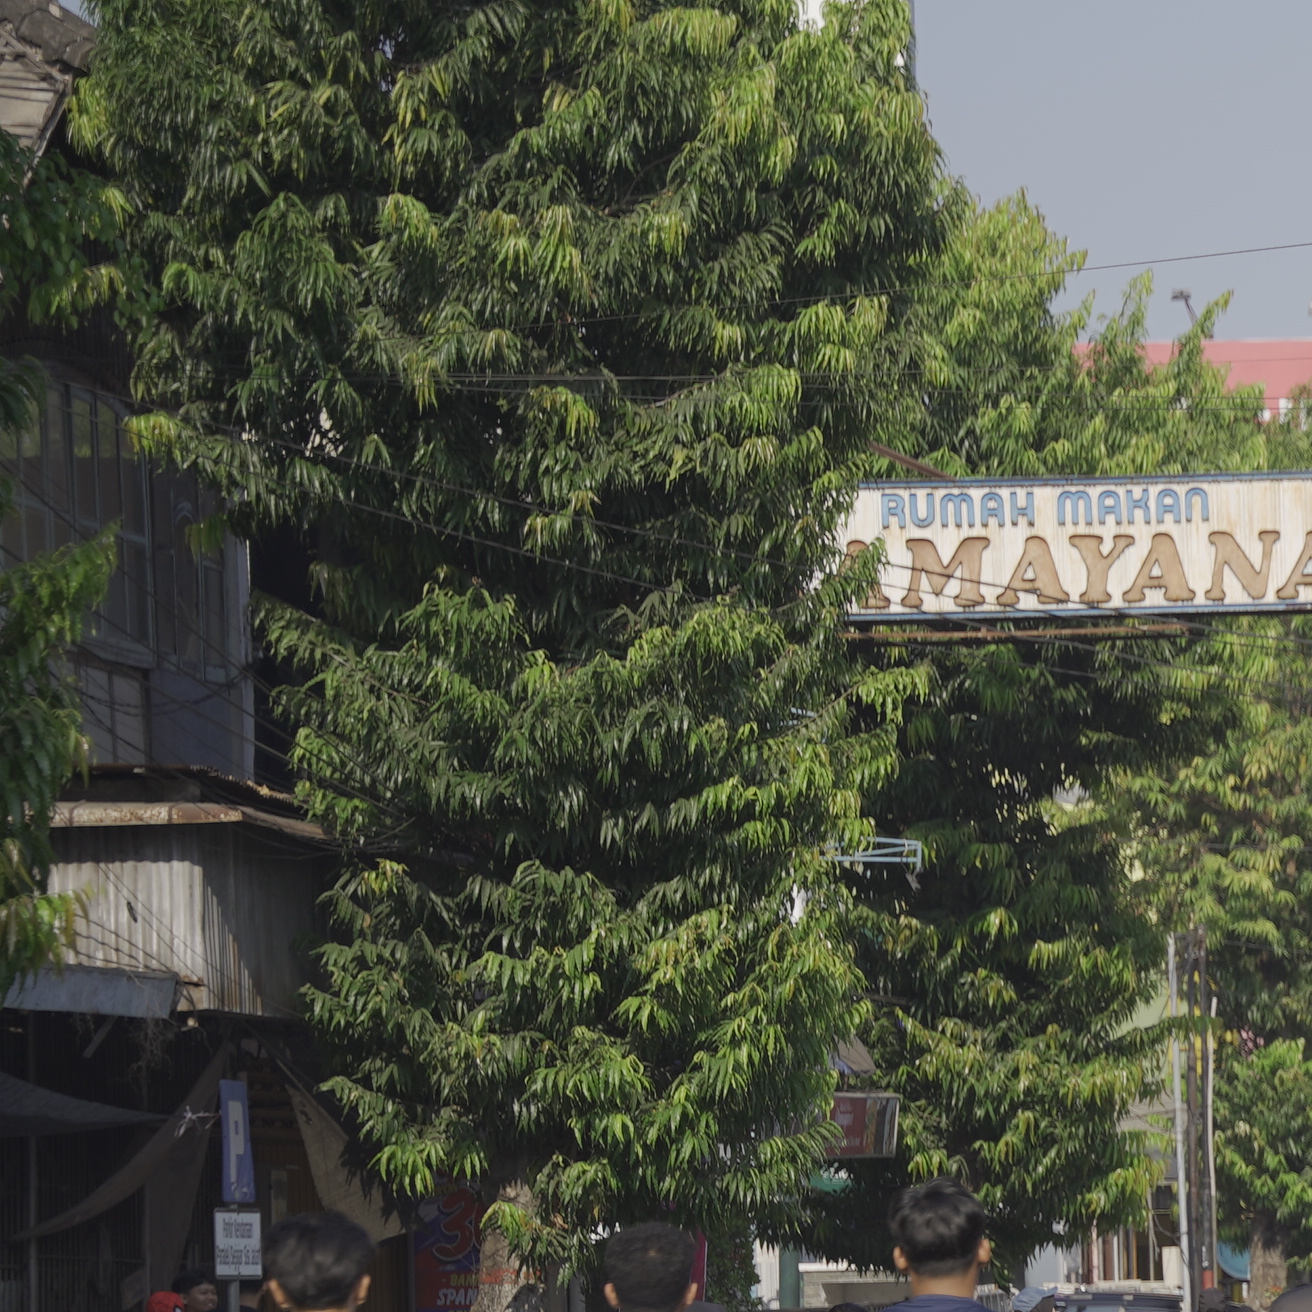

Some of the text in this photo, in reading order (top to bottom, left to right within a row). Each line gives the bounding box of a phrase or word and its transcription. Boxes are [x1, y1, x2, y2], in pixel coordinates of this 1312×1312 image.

[881, 488, 1210, 528] RUMAH MAKAN
[436, 1288, 478, 1306] SPAN
